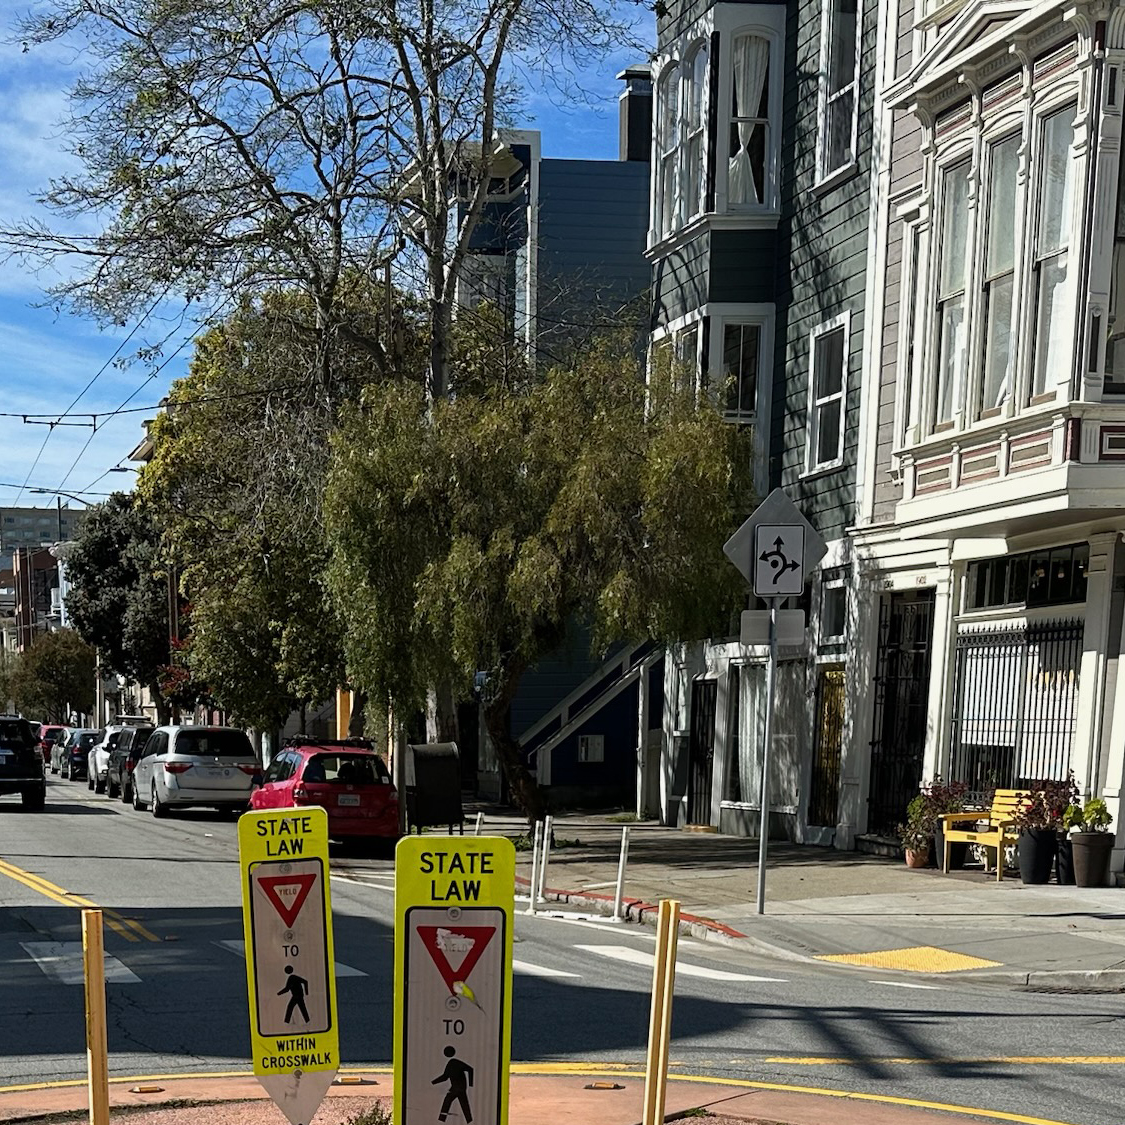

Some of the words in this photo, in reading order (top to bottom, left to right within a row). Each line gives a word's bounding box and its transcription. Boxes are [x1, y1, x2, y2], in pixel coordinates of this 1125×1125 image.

[256, 816, 313, 836] STATE
[266, 839, 304, 856] LAW
[419, 852, 494, 874] STATE
[431, 880, 481, 901] LAW
[282, 944, 300, 958] TO
[443, 1019, 465, 1036] TO
[276, 1036, 316, 1052] WITHIN
[261, 1052, 332, 1069] CROSSWALK
